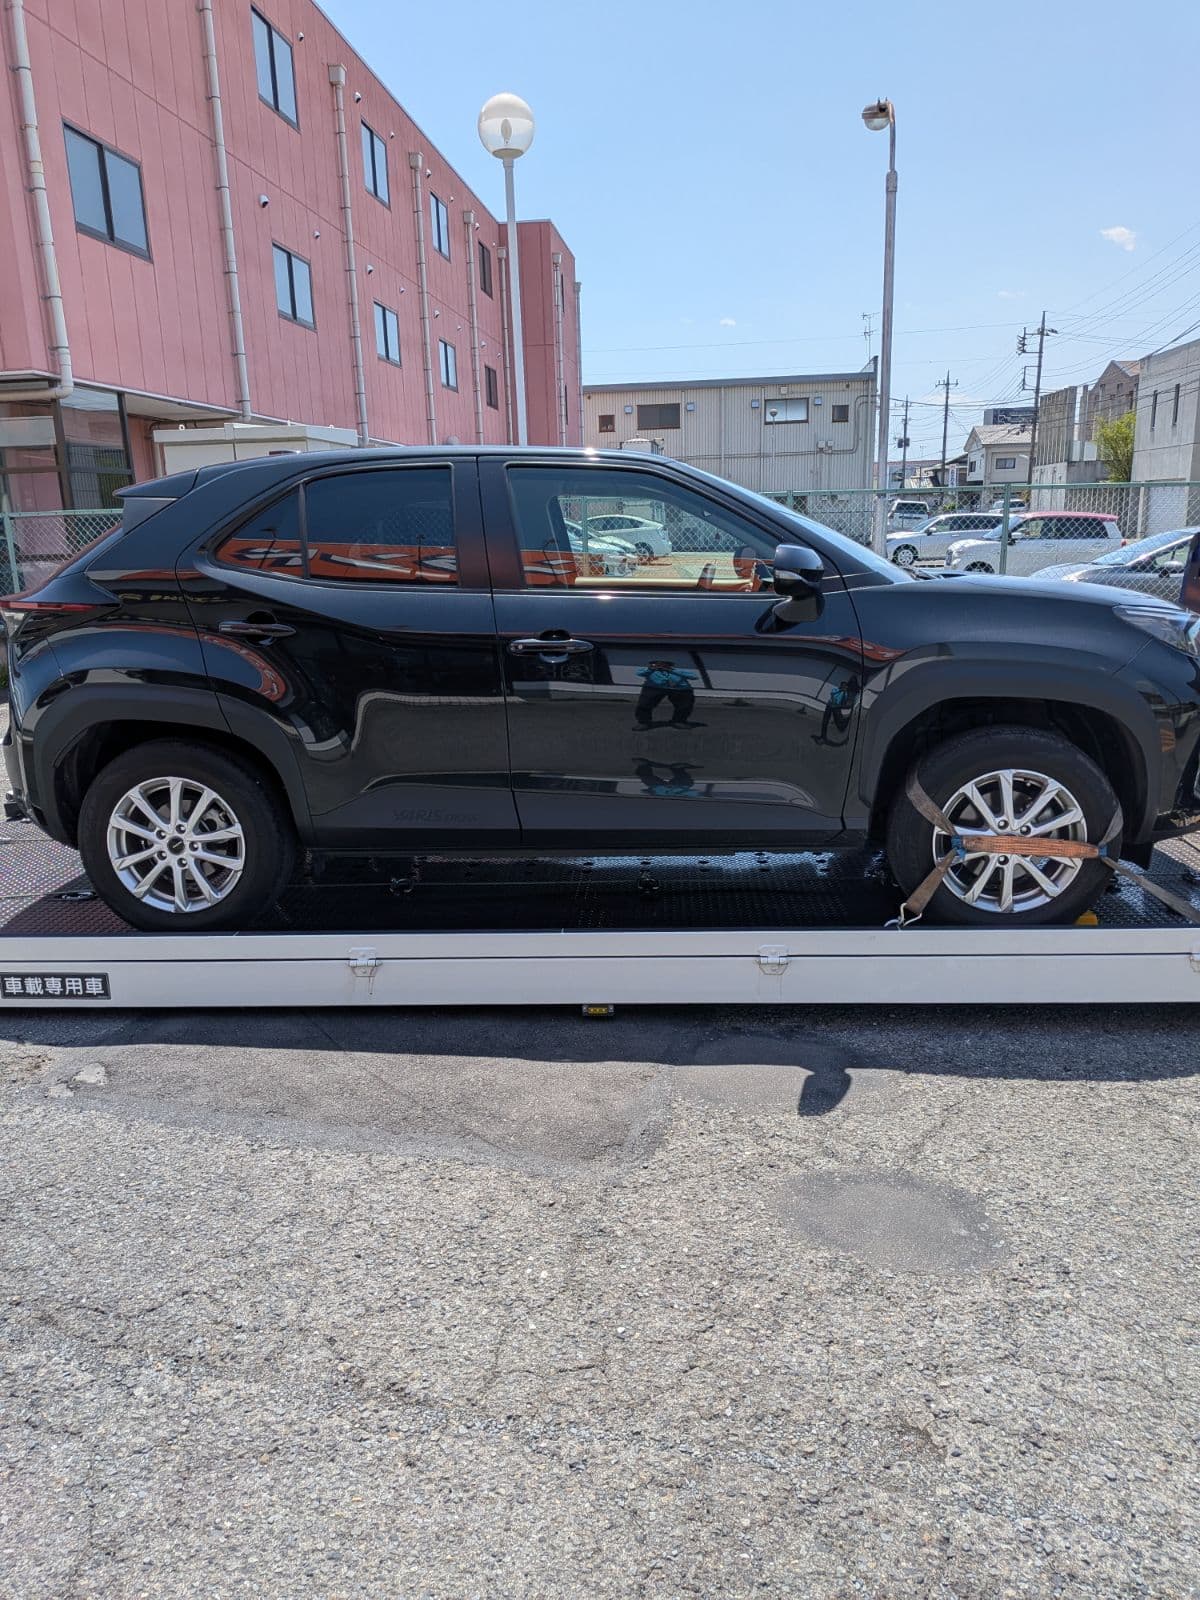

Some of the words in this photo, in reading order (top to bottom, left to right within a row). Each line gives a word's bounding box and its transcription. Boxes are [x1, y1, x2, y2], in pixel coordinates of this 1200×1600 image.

[4, 976, 105, 995] 車載専用車
